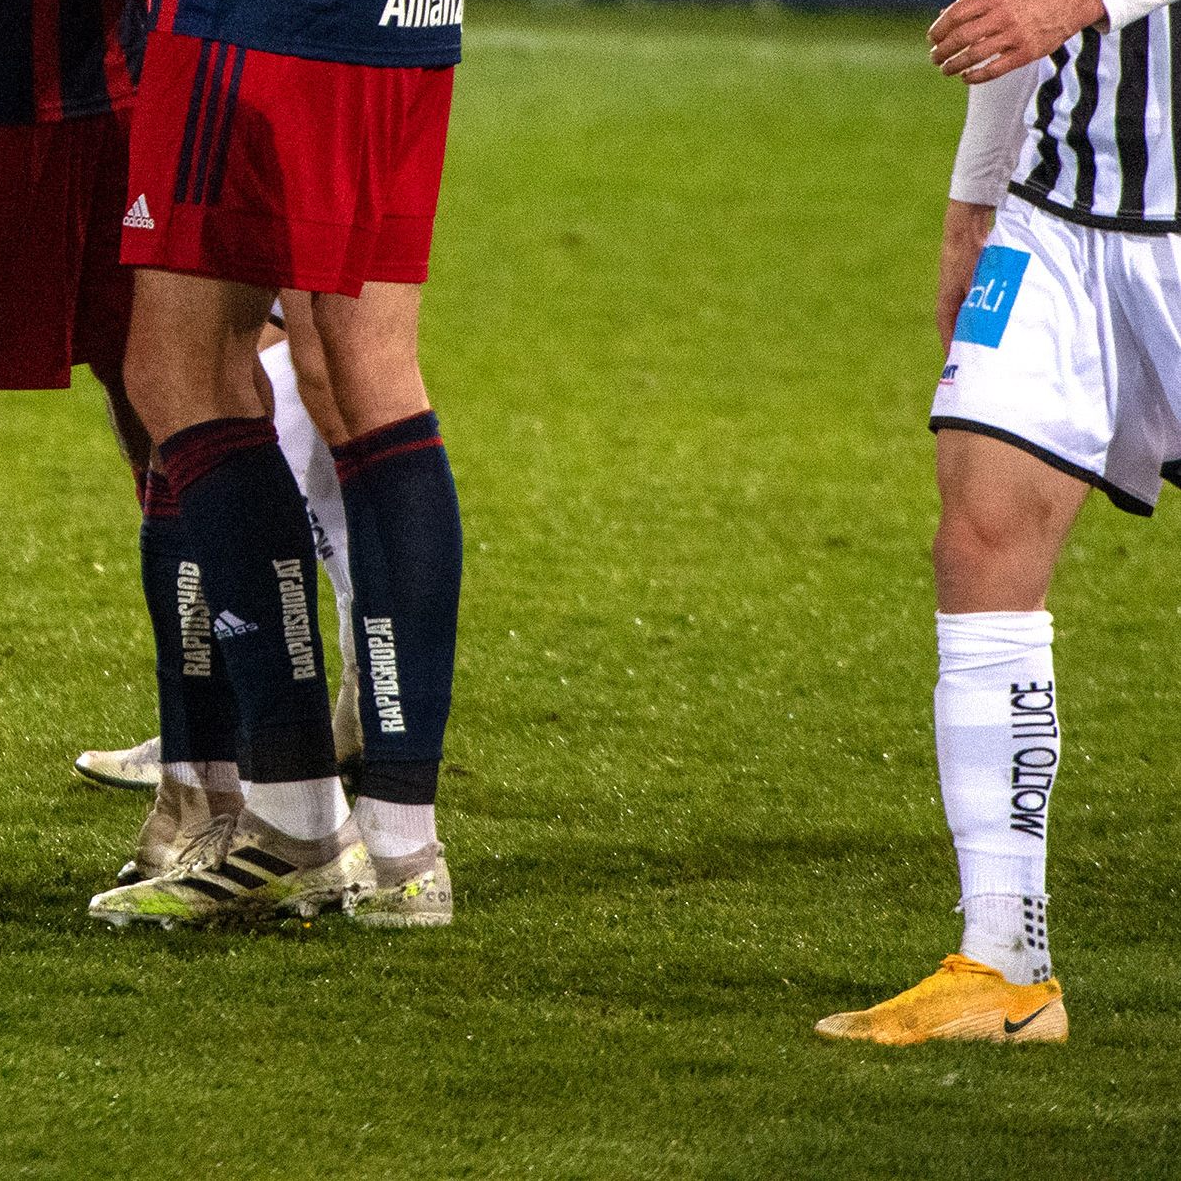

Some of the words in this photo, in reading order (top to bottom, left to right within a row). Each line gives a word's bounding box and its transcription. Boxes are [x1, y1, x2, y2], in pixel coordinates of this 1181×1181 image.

[272, 559, 316, 680] RAPIDSHOP.AT
[363, 616, 406, 733] RAPIDSHOP.AT
[1010, 680, 1057, 739] LUCE
[1010, 746, 1057, 840] MOLTO
